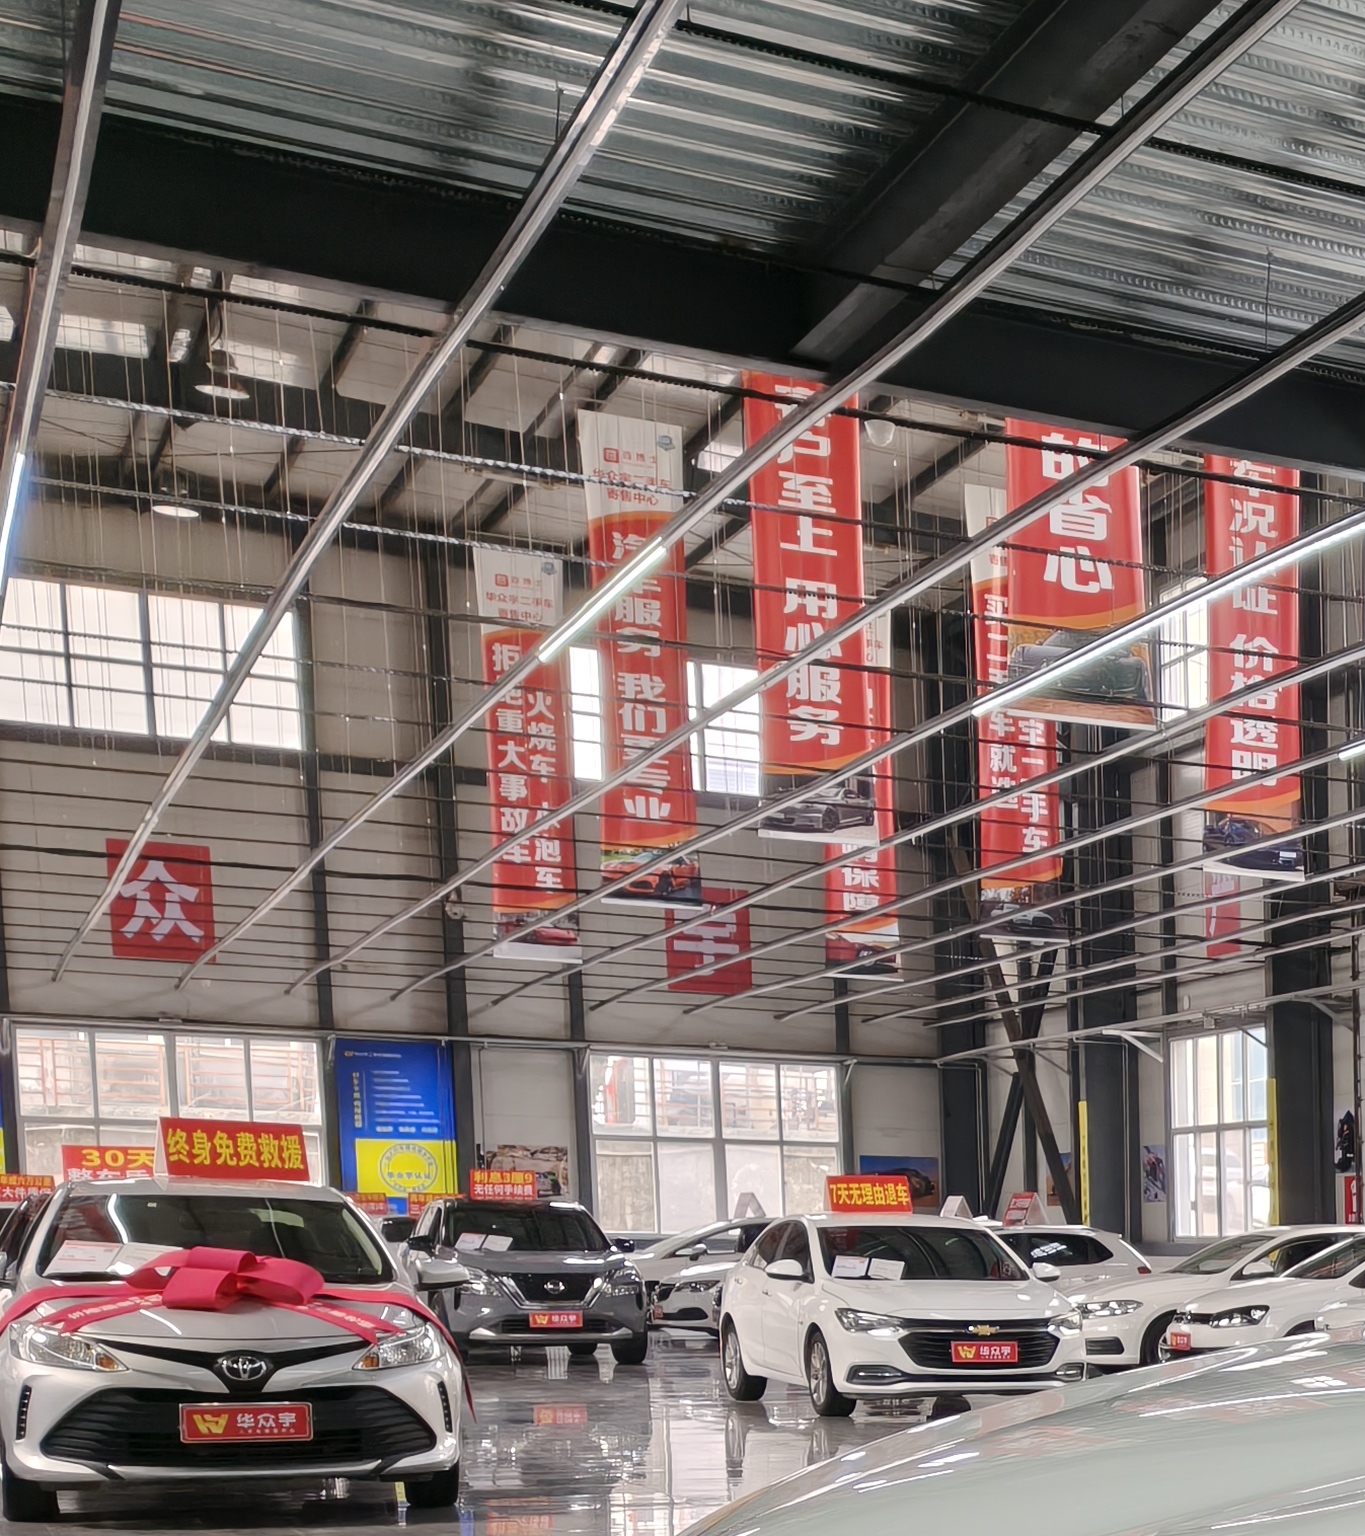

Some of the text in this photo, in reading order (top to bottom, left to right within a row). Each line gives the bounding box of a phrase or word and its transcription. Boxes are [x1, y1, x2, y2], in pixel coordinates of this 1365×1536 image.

[784, 577, 843, 746] 用心服务
[1230, 634, 1279, 787] 价格透明
[119, 860, 205, 944] 众
[81, 1148, 155, 1168] 30天
[166, 1127, 305, 1170] 终身免费救援
[829, 1182, 910, 1207] 7天无理由退车
